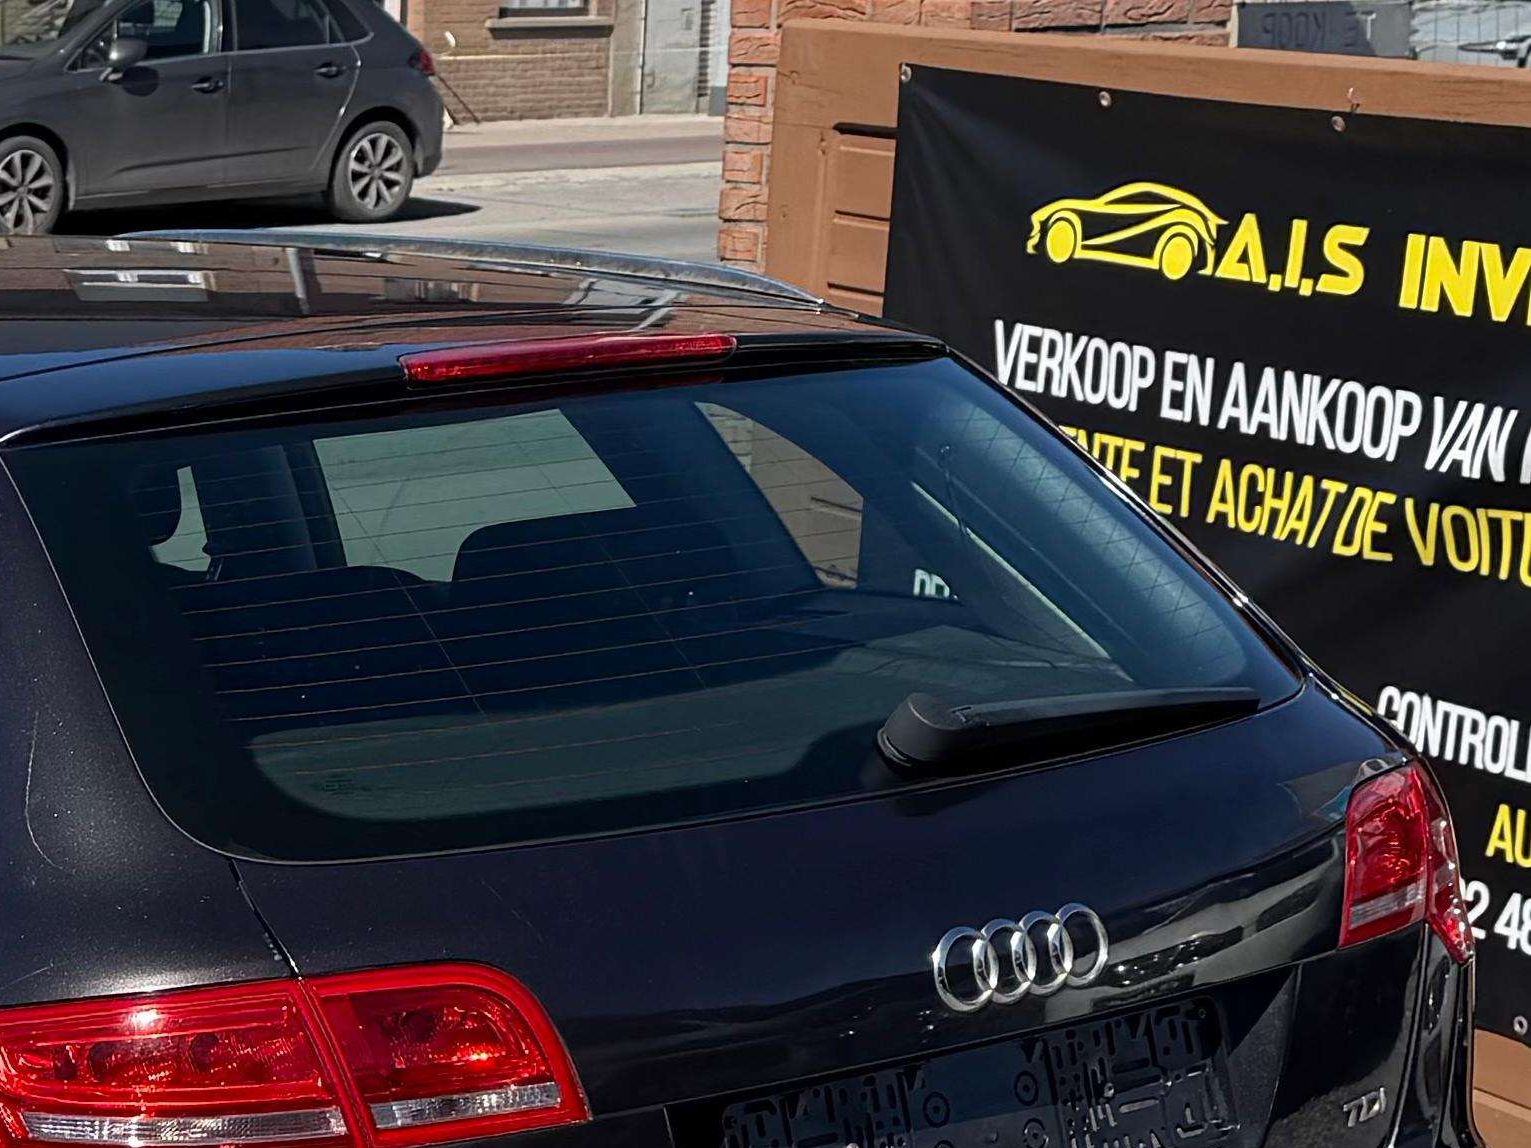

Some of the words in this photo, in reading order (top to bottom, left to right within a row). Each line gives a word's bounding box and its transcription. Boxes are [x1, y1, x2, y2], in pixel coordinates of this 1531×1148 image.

[1214, 213, 1370, 297] A.I.S
[1398, 233, 1531, 327] INV
[994, 319, 1156, 412] VERKOOP
[1160, 351, 1215, 426] EN
[1217, 362, 1422, 462] AANKOOP
[1424, 396, 1519, 483] VAN
[1149, 446, 1203, 518] ET
[1206, 459, 1348, 548] ACHAT
[1332, 486, 1398, 562] DE
[1377, 685, 1531, 784] CONTROL
[1459, 877, 1490, 940] 2
[1343, 1087, 1387, 1128] TDI
